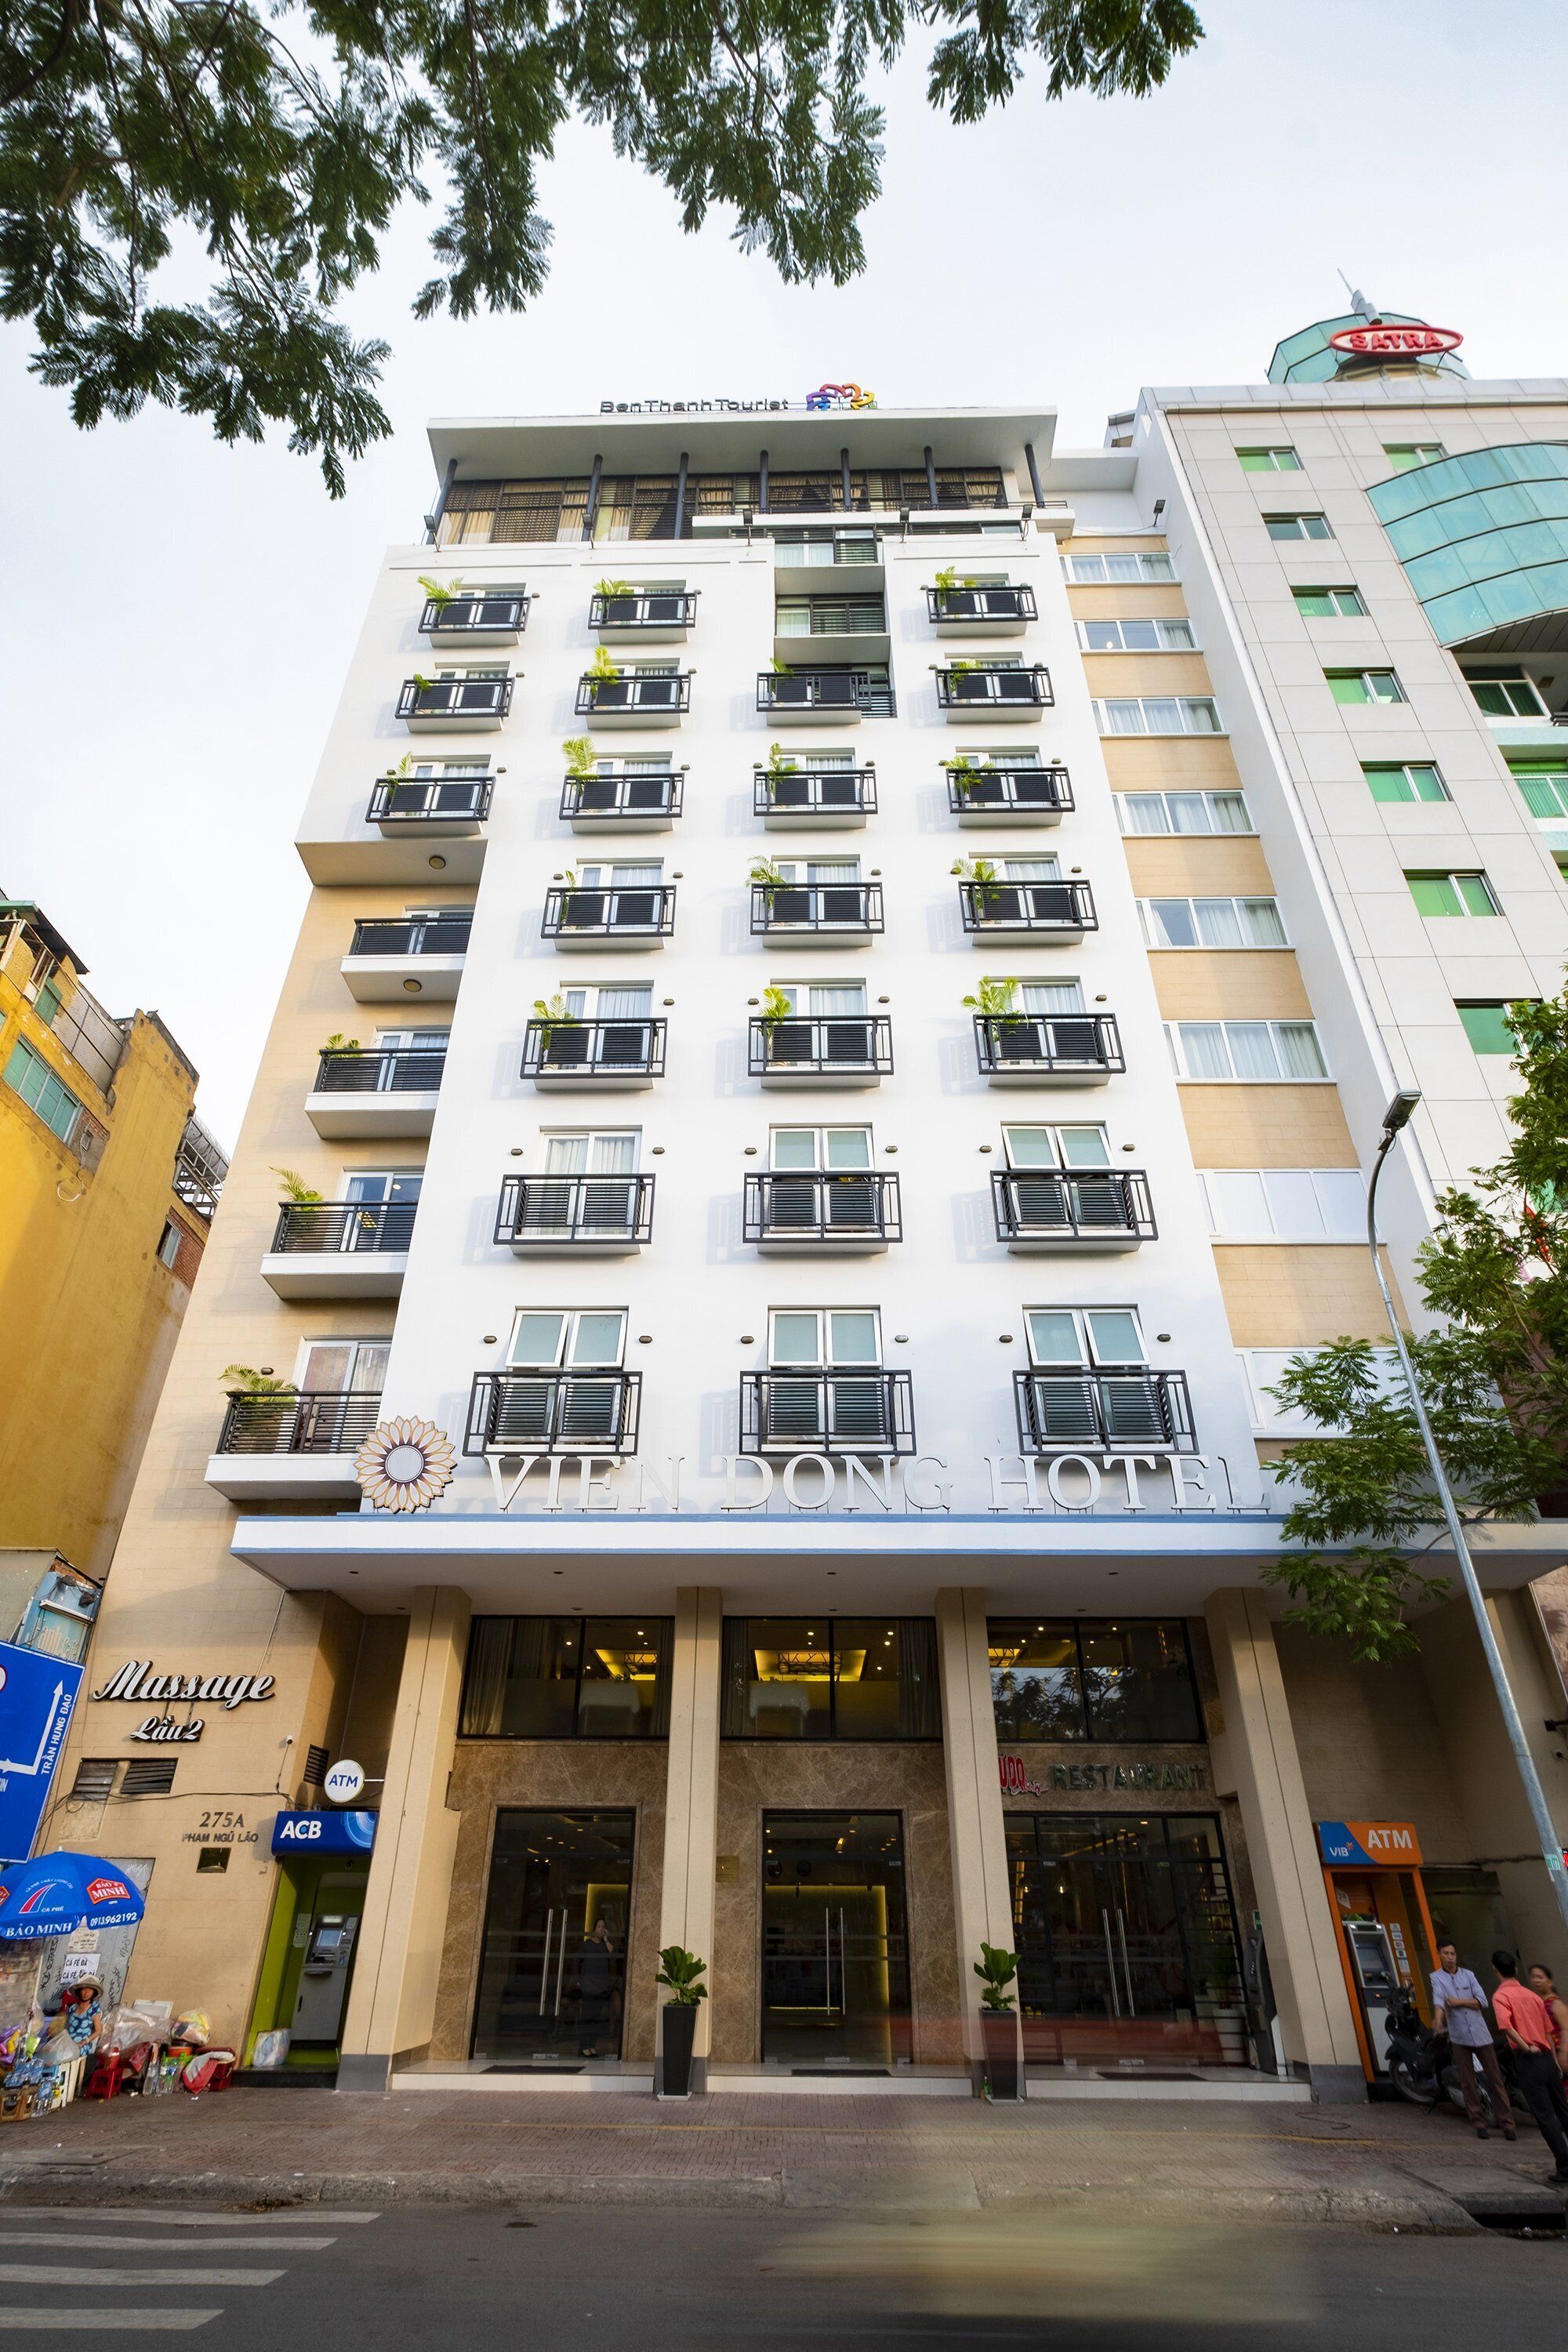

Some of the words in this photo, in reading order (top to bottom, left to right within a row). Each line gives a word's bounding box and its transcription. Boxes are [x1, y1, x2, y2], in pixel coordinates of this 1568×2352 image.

[1349, 332, 1443, 350] SATRA
[483, 1454, 684, 1510] VIEN
[720, 1454, 953, 1510] DONG
[984, 1454, 1272, 1510] HOTEL
[92, 1660, 276, 1711] Massage
[41, 1746, 58, 1775] TRẦN
[50, 1715, 67, 1745] HƯNG
[60, 1693, 73, 1715] ĐẠO
[183, 1719, 205, 1742] 2
[328, 1774, 358, 1788] ATM
[1051, 1762, 1205, 1791] RESTAURANT
[199, 1811, 245, 1828] 275A
[238, 1831, 259, 1842] LÃO
[280, 1820, 322, 1840] ACB
[1368, 1830, 1413, 1849] ATM
[1330, 1846, 1349, 1857] VIB
[92, 1886, 125, 1900] MINH
[5, 1922, 34, 1937] BẢO
[36, 1922, 72, 1934] MINH
